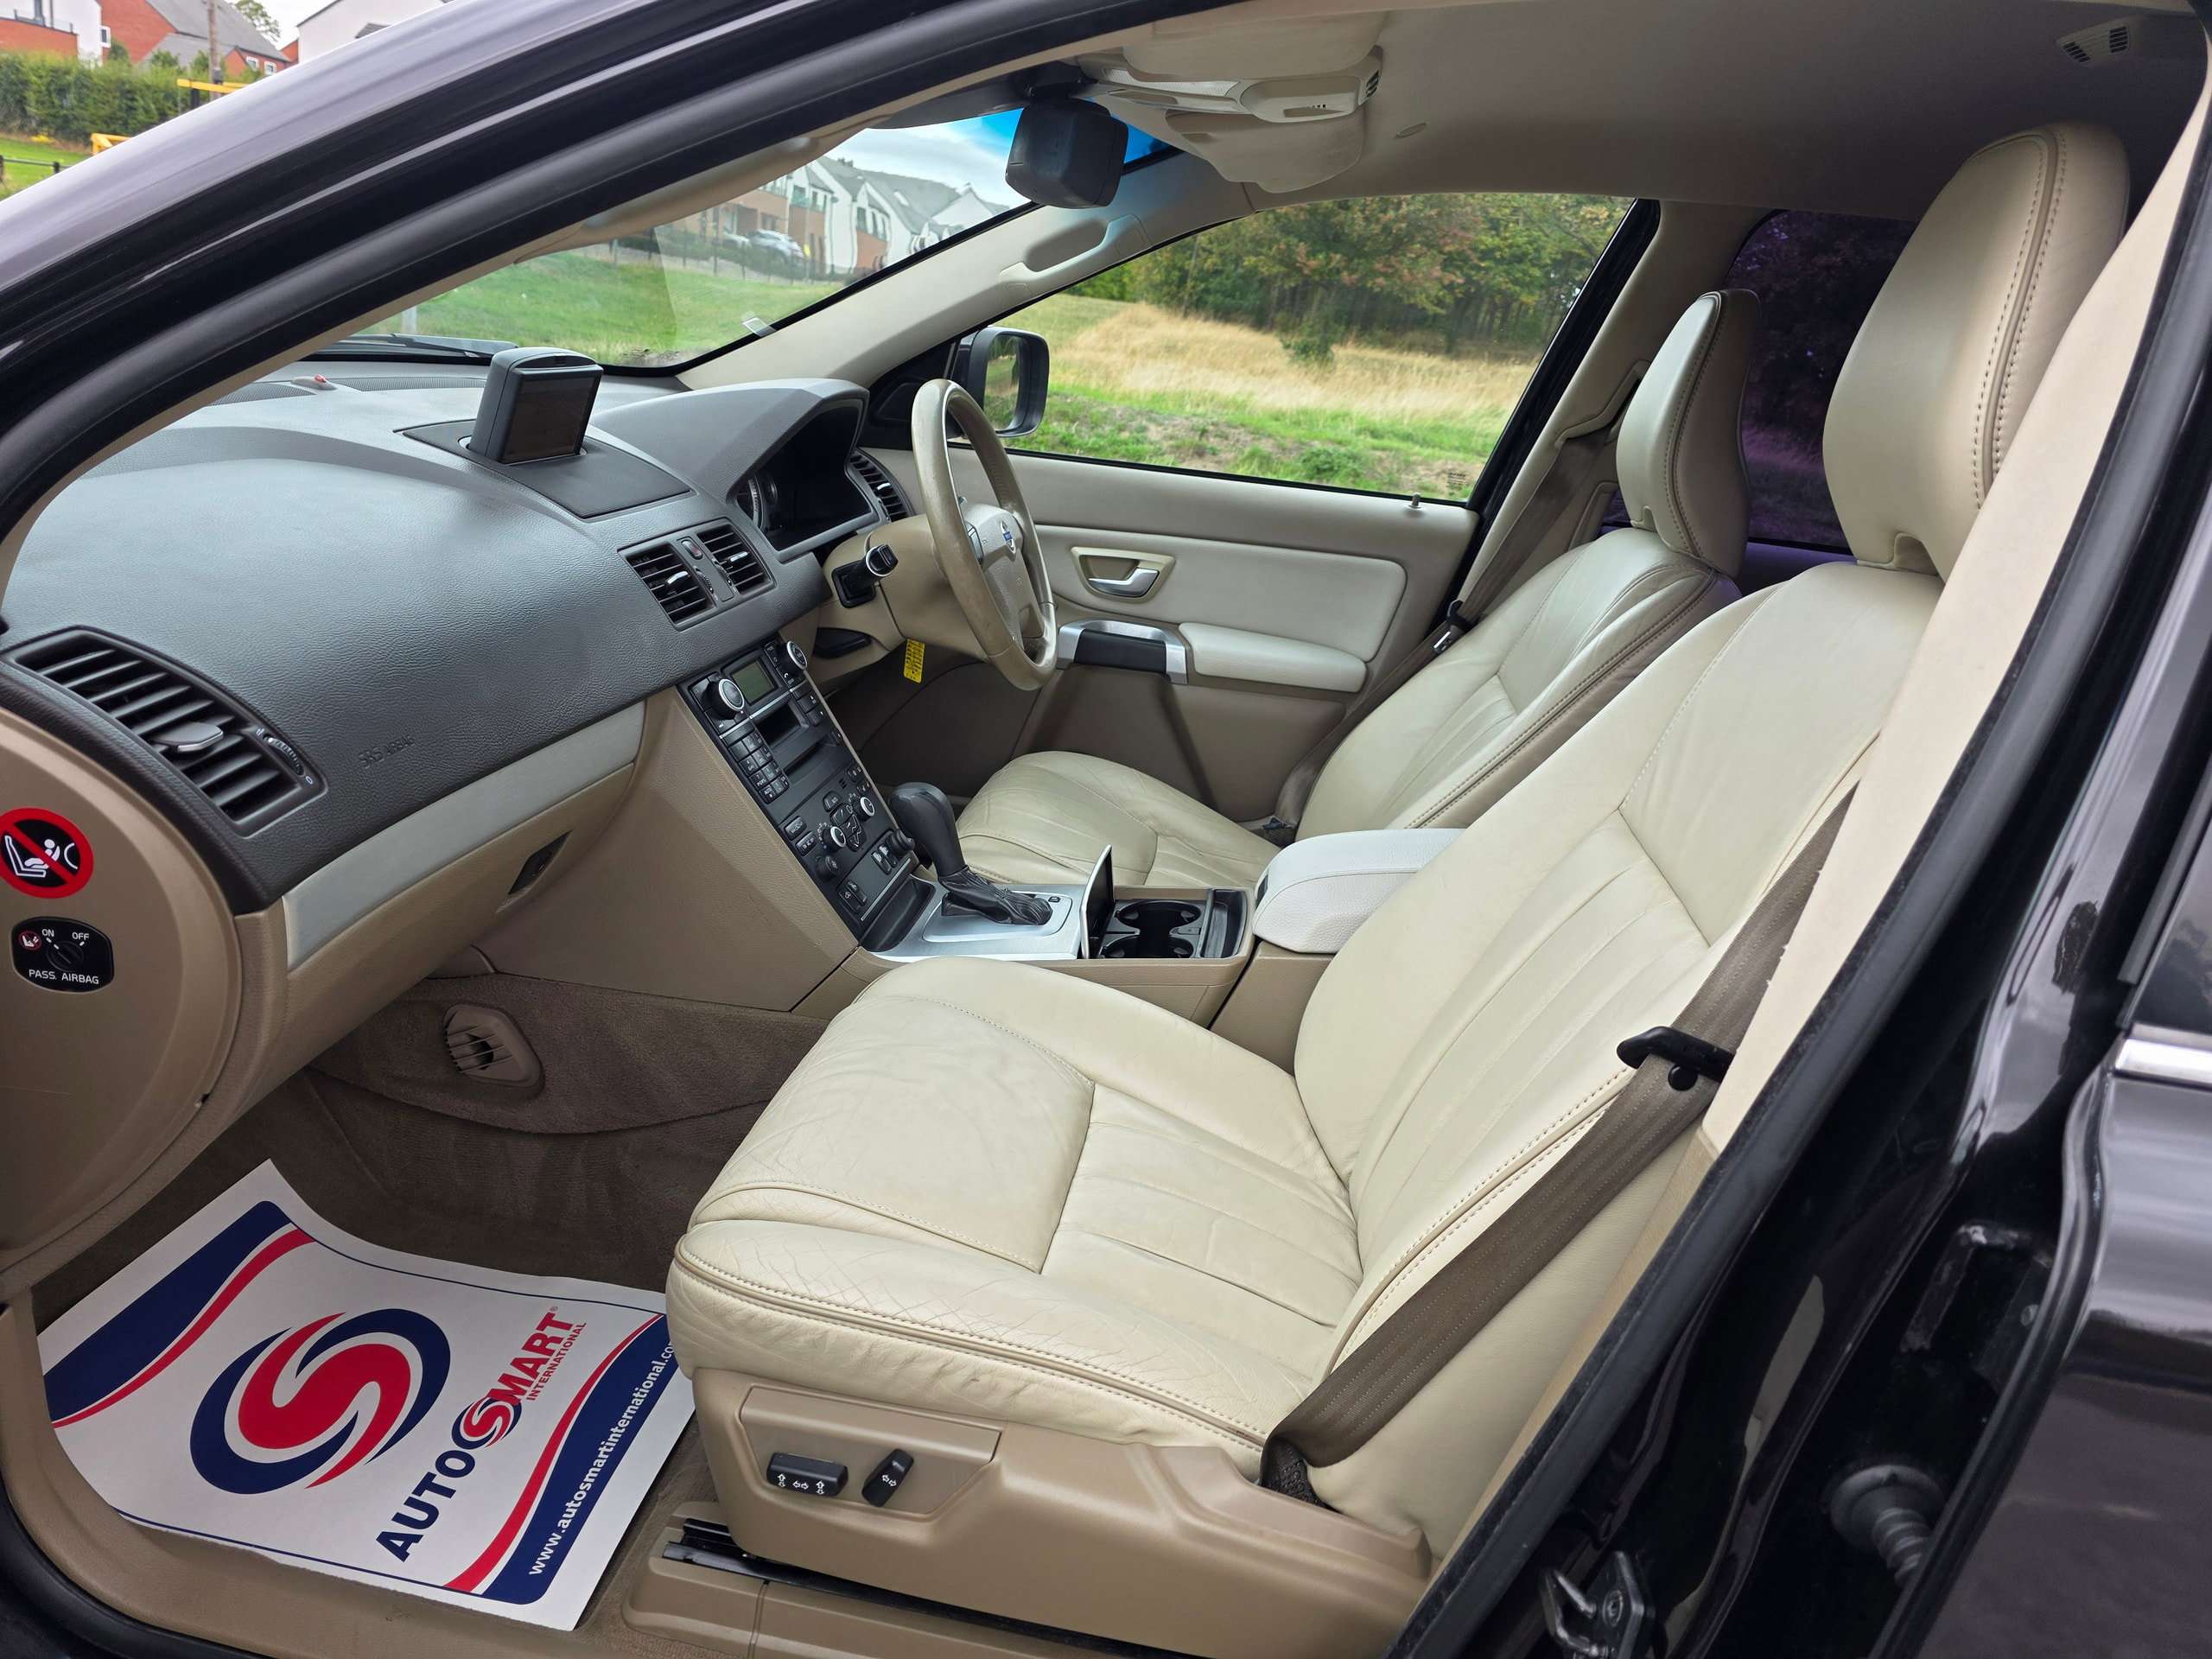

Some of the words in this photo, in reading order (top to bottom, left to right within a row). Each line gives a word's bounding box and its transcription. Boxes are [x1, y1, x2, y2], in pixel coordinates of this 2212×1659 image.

[41, 928, 54, 938] ON
[72, 931, 90, 941] OFF
[29, 969, 57, 981] PASS.
[61, 972, 99, 985] AIRBAG
[525, 1322, 588, 1401] INTERNATIONAL
[528, 1341, 675, 1576] www.autosmartinternational.co
